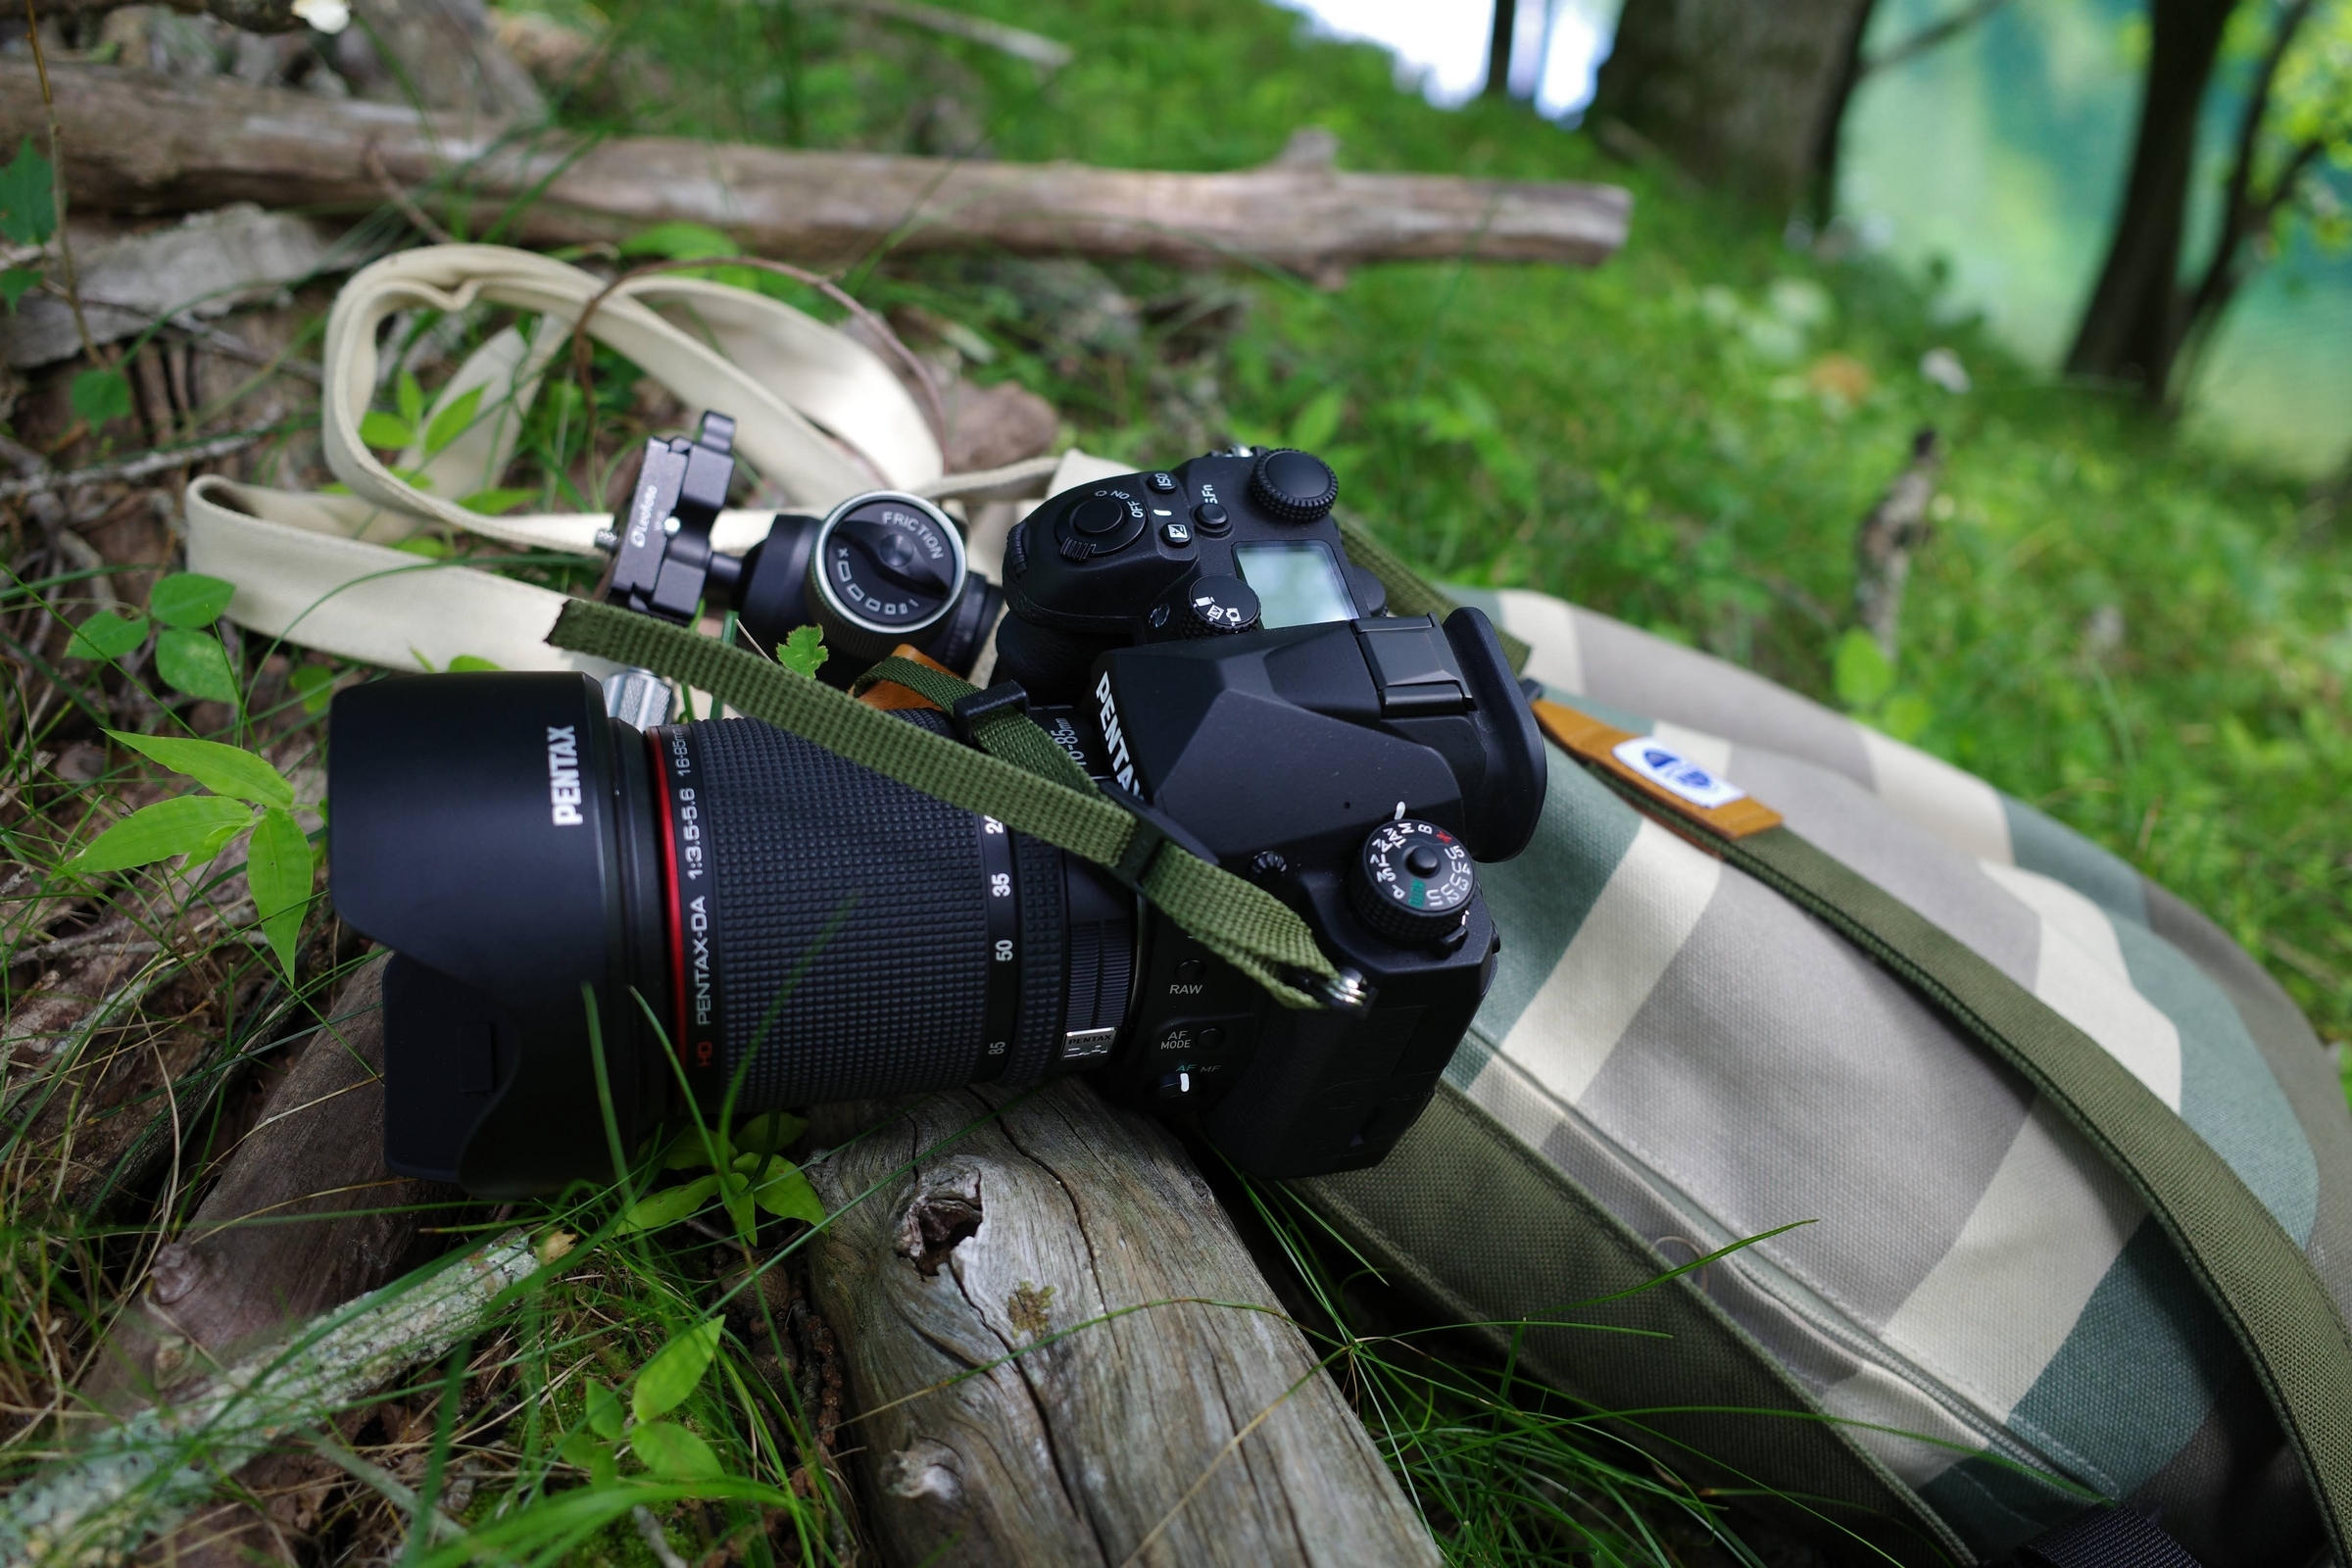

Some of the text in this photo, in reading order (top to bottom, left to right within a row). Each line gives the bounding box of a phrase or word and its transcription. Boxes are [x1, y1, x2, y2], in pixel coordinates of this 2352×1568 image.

[1154, 472, 1172, 487] ISO
[1127, 501, 1144, 518] OFF
[882, 511, 945, 561] FRICTION
[547, 725, 583, 826] PENTAX
[984, 814, 1004, 834] 2
[1397, 822, 1415, 834] M
[1417, 823, 1433, 835] B
[679, 788, 704, 880] 1:3.5-5.6
[1444, 845, 1465, 860] U5
[1450, 860, 1471, 875] U4
[991, 872, 1010, 898] 35
[1449, 872, 1469, 892] U3
[1392, 884, 1405, 900] P
[1426, 889, 1444, 906] U1
[1440, 883, 1460, 904] U2
[995, 939, 1013, 961] 50
[689, 895, 711, 1025] PENTAX-DA
[1169, 984, 1202, 995] RAW
[1068, 1034, 1111, 1046] PENTAX
[1167, 1030, 1188, 1041] AF
[988, 1041, 1006, 1055] 85
[1160, 1039, 1191, 1050] MODE
[697, 1041, 713, 1067] HD
[1200, 1064, 1221, 1073] MF
